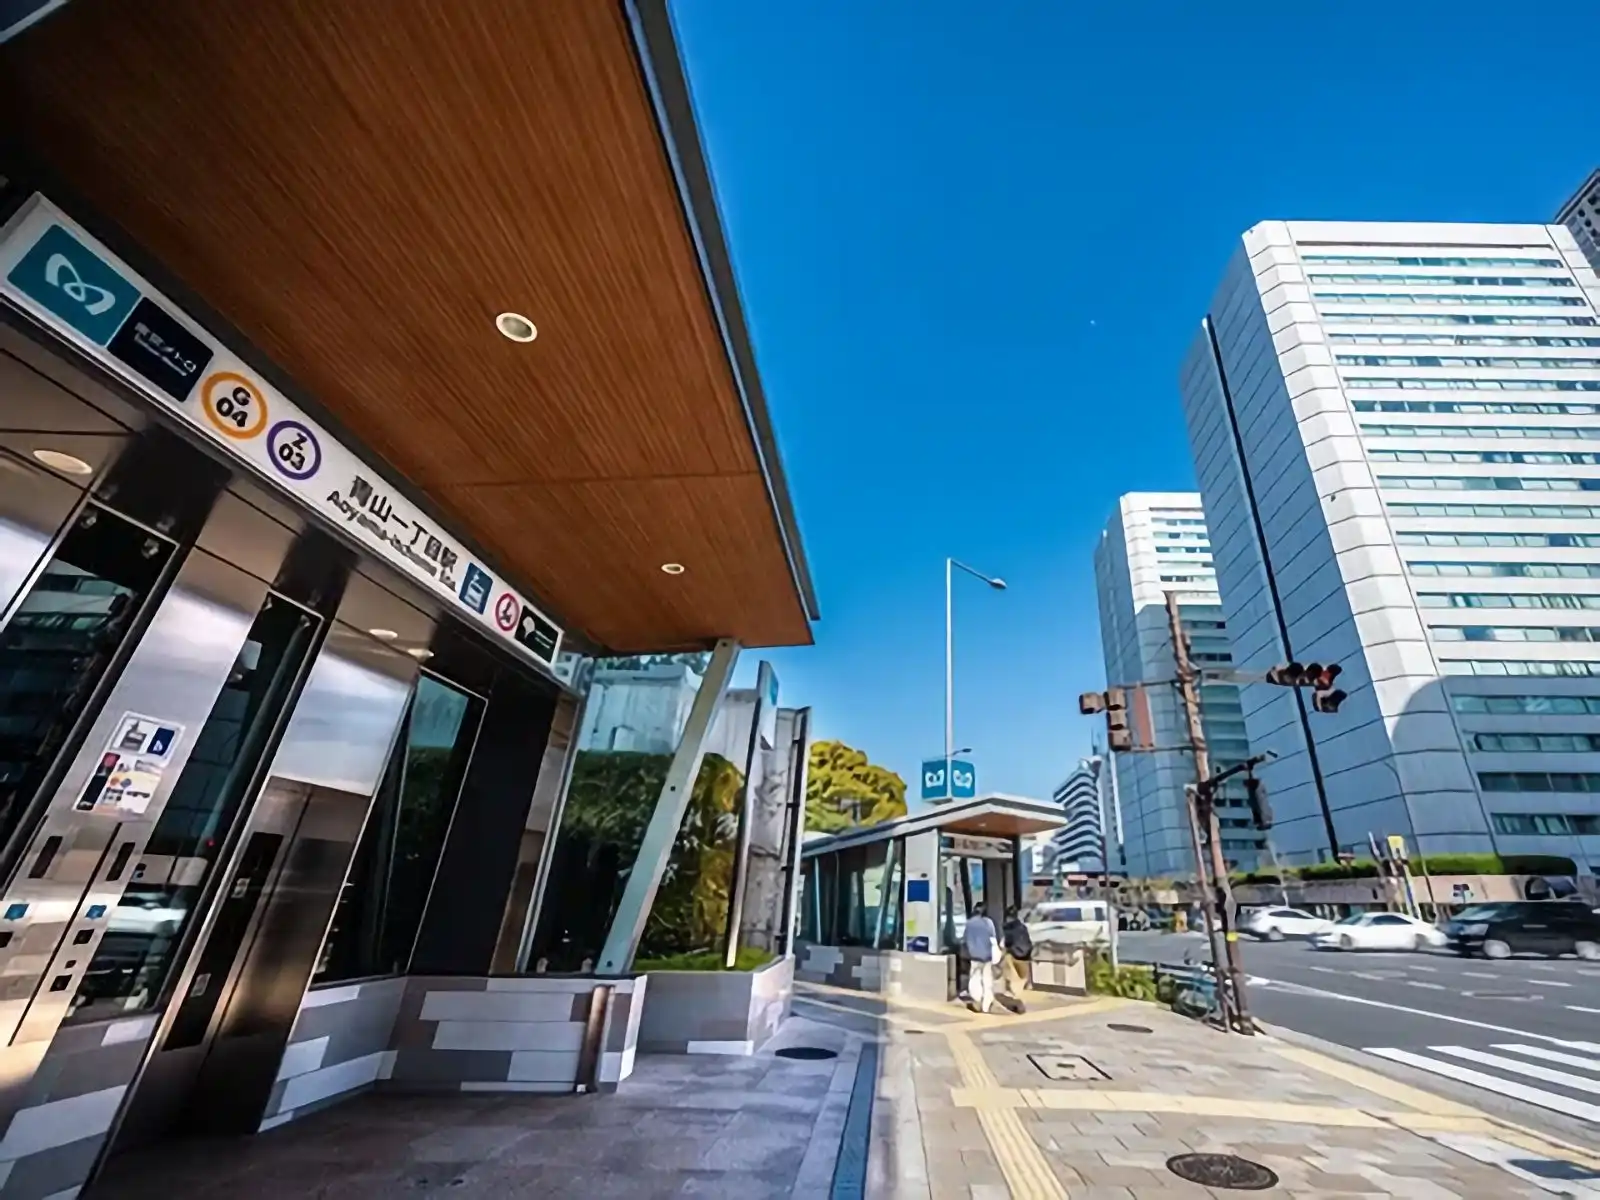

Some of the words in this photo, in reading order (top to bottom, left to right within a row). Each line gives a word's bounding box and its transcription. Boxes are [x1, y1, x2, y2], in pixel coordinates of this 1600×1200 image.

[232, 386, 252, 406] G
[216, 397, 248, 427] 04
[292, 432, 308, 451] Z
[278, 443, 305, 471] 03
